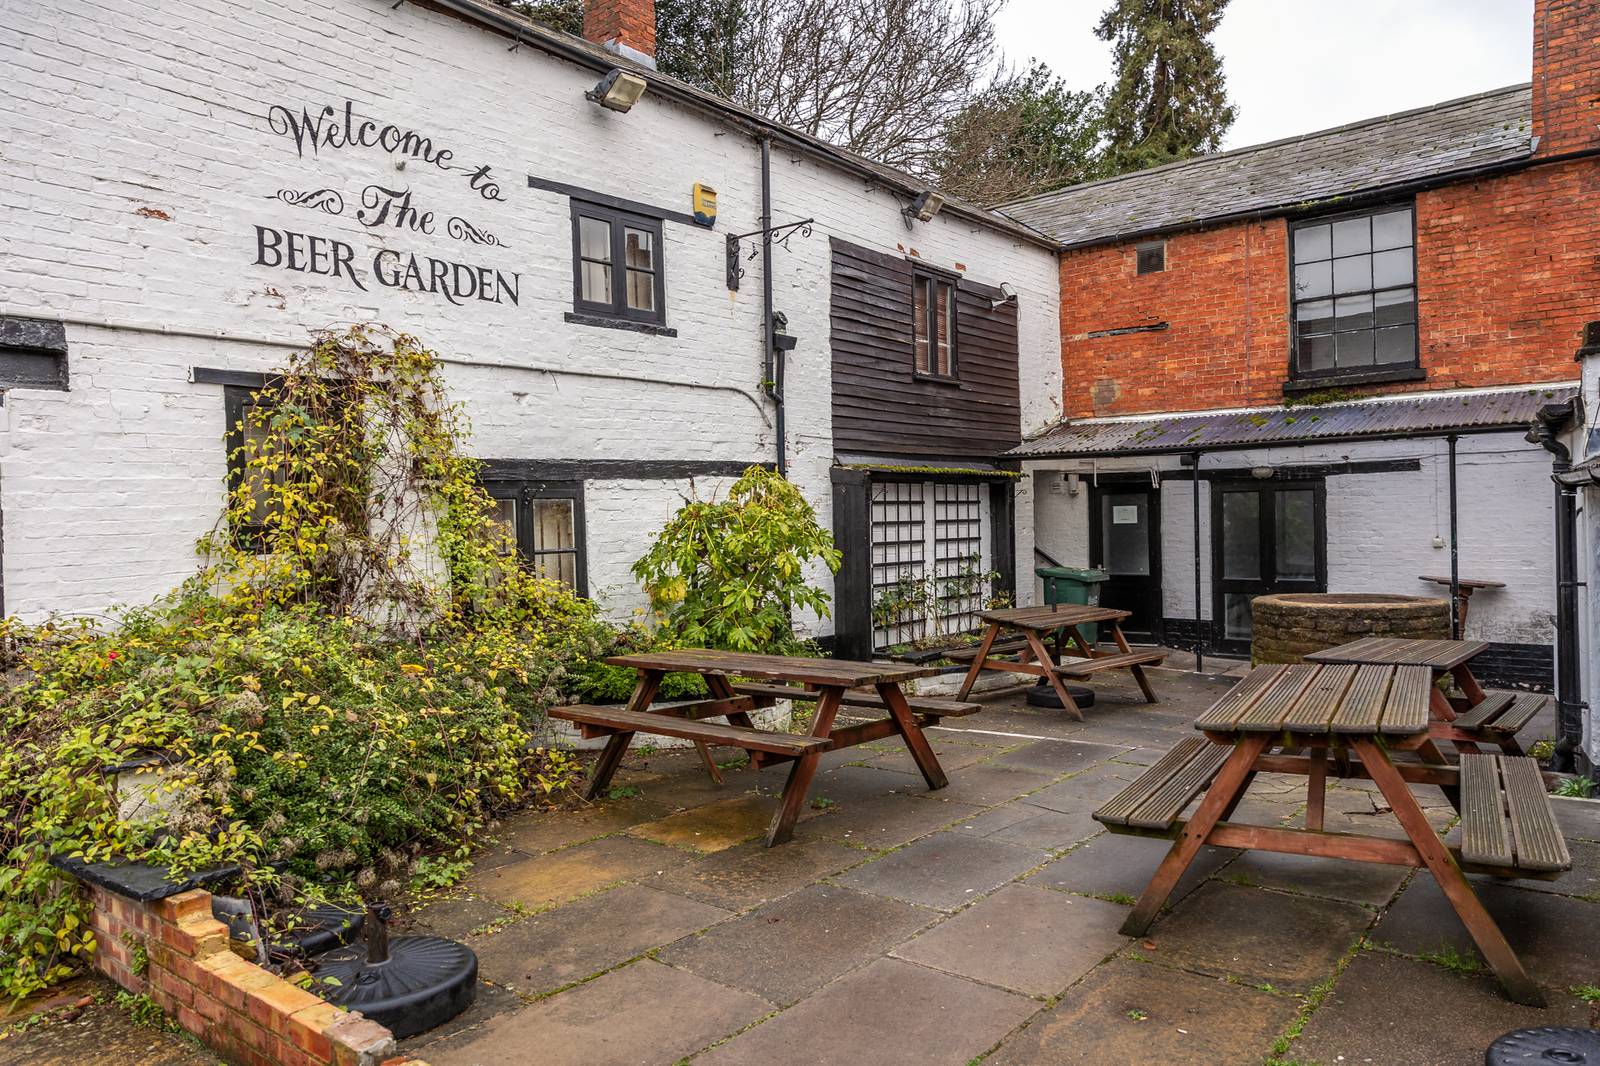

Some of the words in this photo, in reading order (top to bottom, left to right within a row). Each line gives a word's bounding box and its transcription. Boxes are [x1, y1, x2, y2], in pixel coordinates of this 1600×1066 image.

[268, 100, 453, 170] Welcome
[461, 164, 507, 201] to
[356, 184, 436, 235] The
[251, 224, 369, 292] BEER
[373, 250, 522, 306] GARDEN
